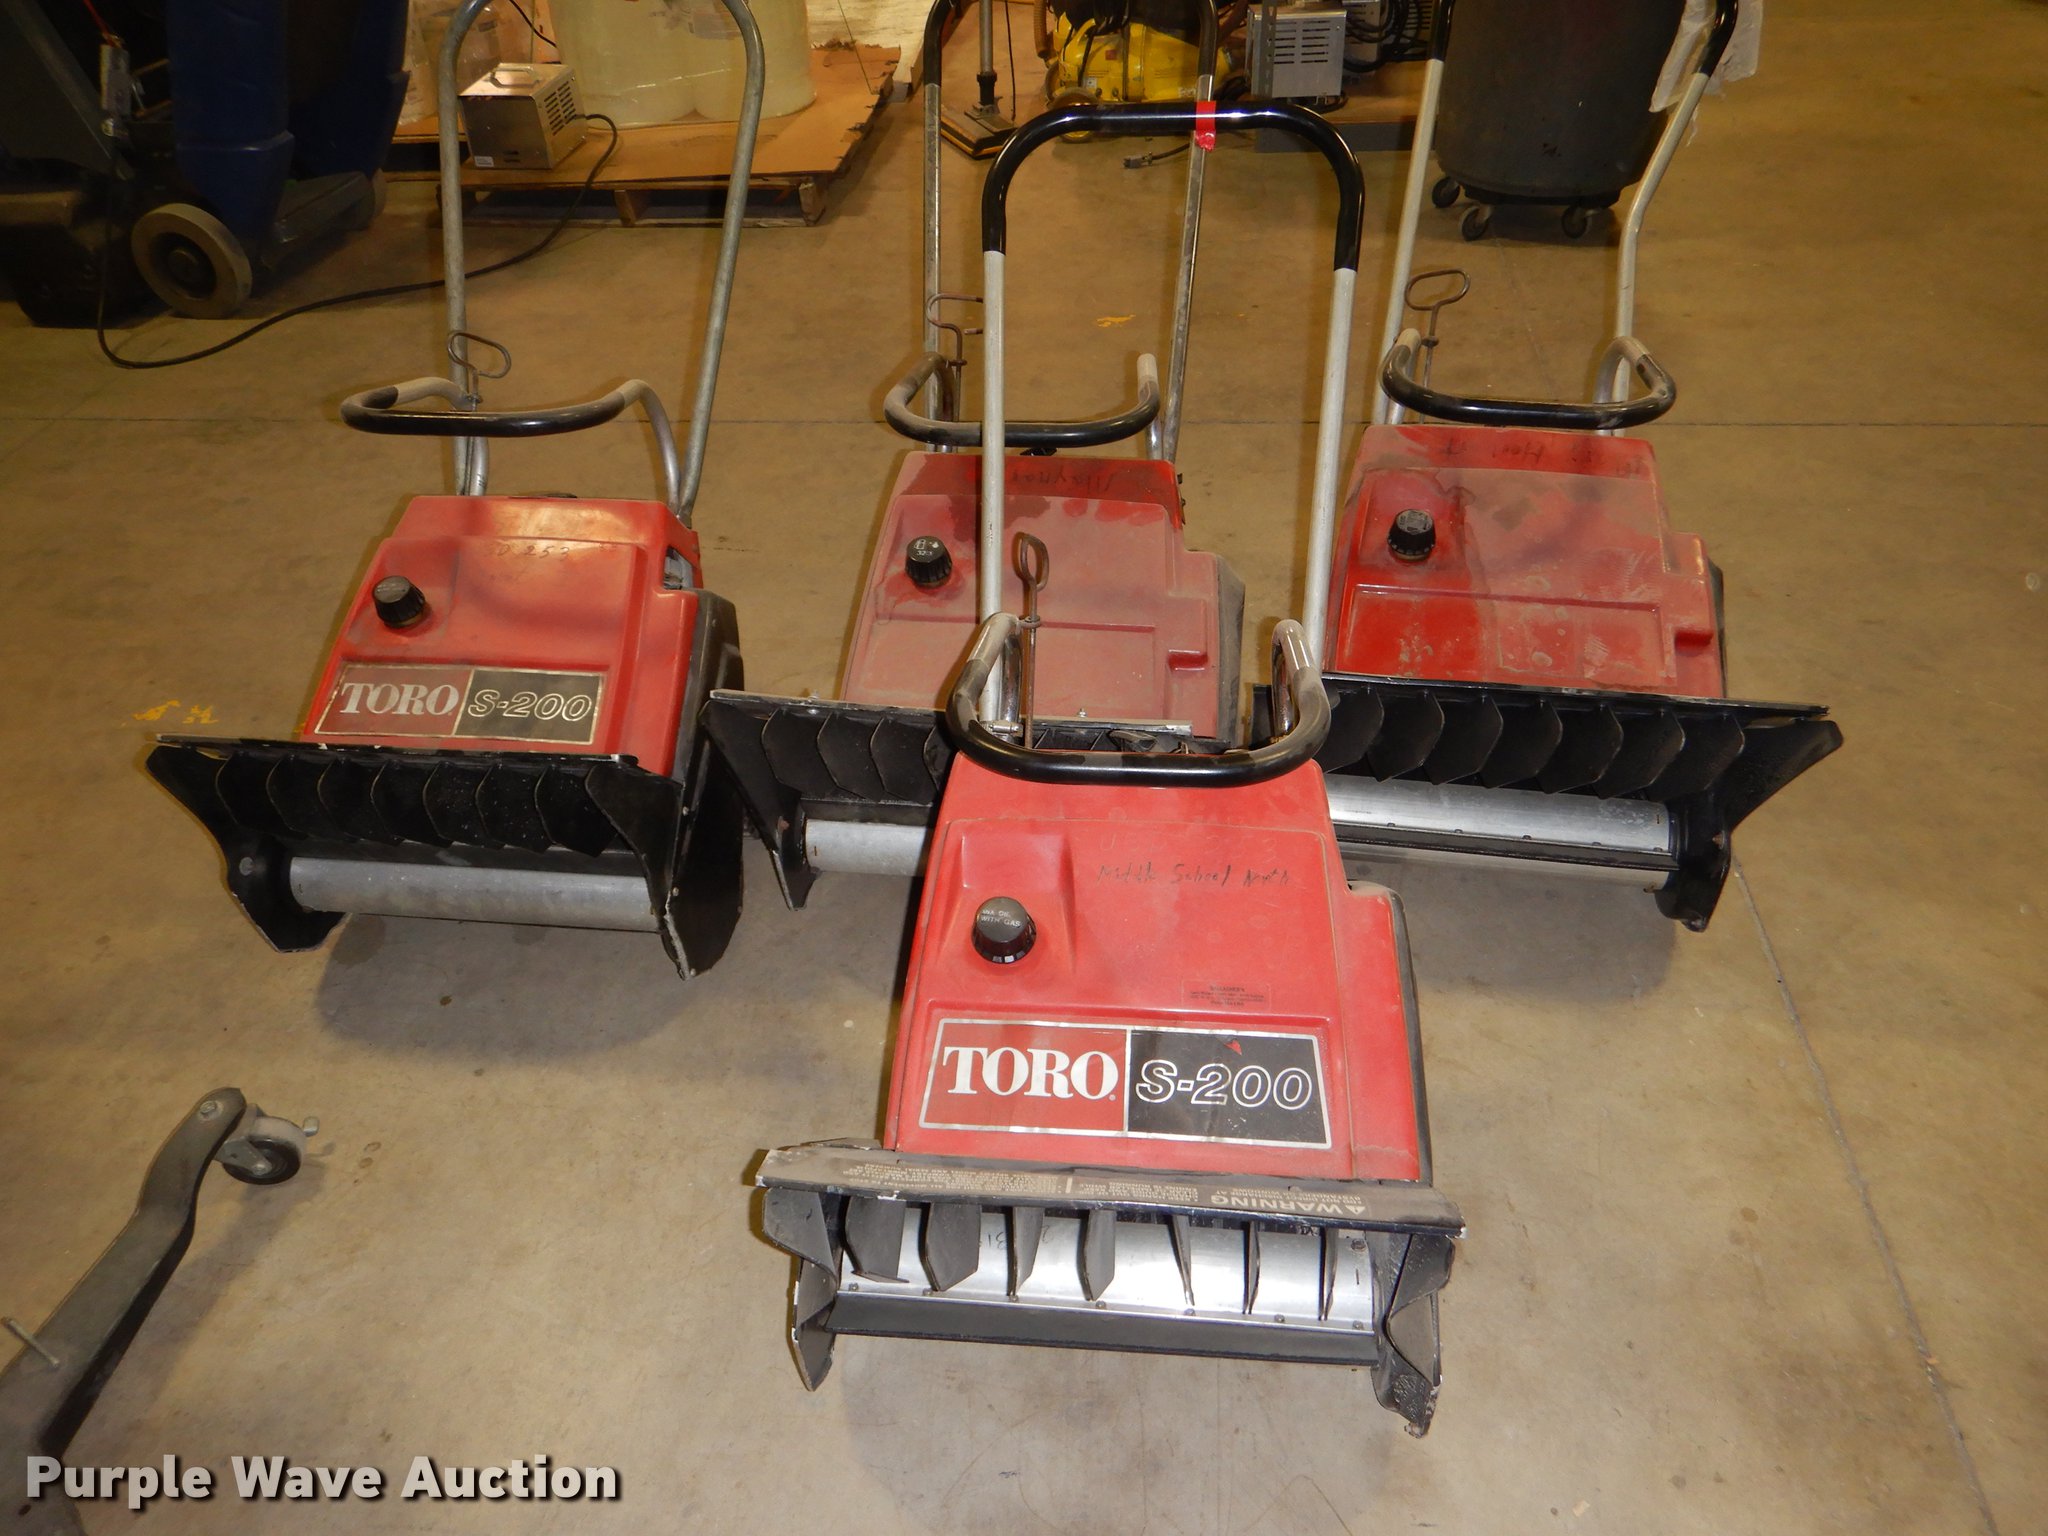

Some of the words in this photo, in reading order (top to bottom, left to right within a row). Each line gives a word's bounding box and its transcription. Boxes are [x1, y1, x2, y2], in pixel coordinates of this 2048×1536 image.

[339, 682, 459, 717] TORO
[467, 688, 593, 722] S-200
[942, 1046, 1119, 1100] TORO
[1135, 1059, 1313, 1111] S-200
[1210, 1194, 1343, 1215] WARNING
